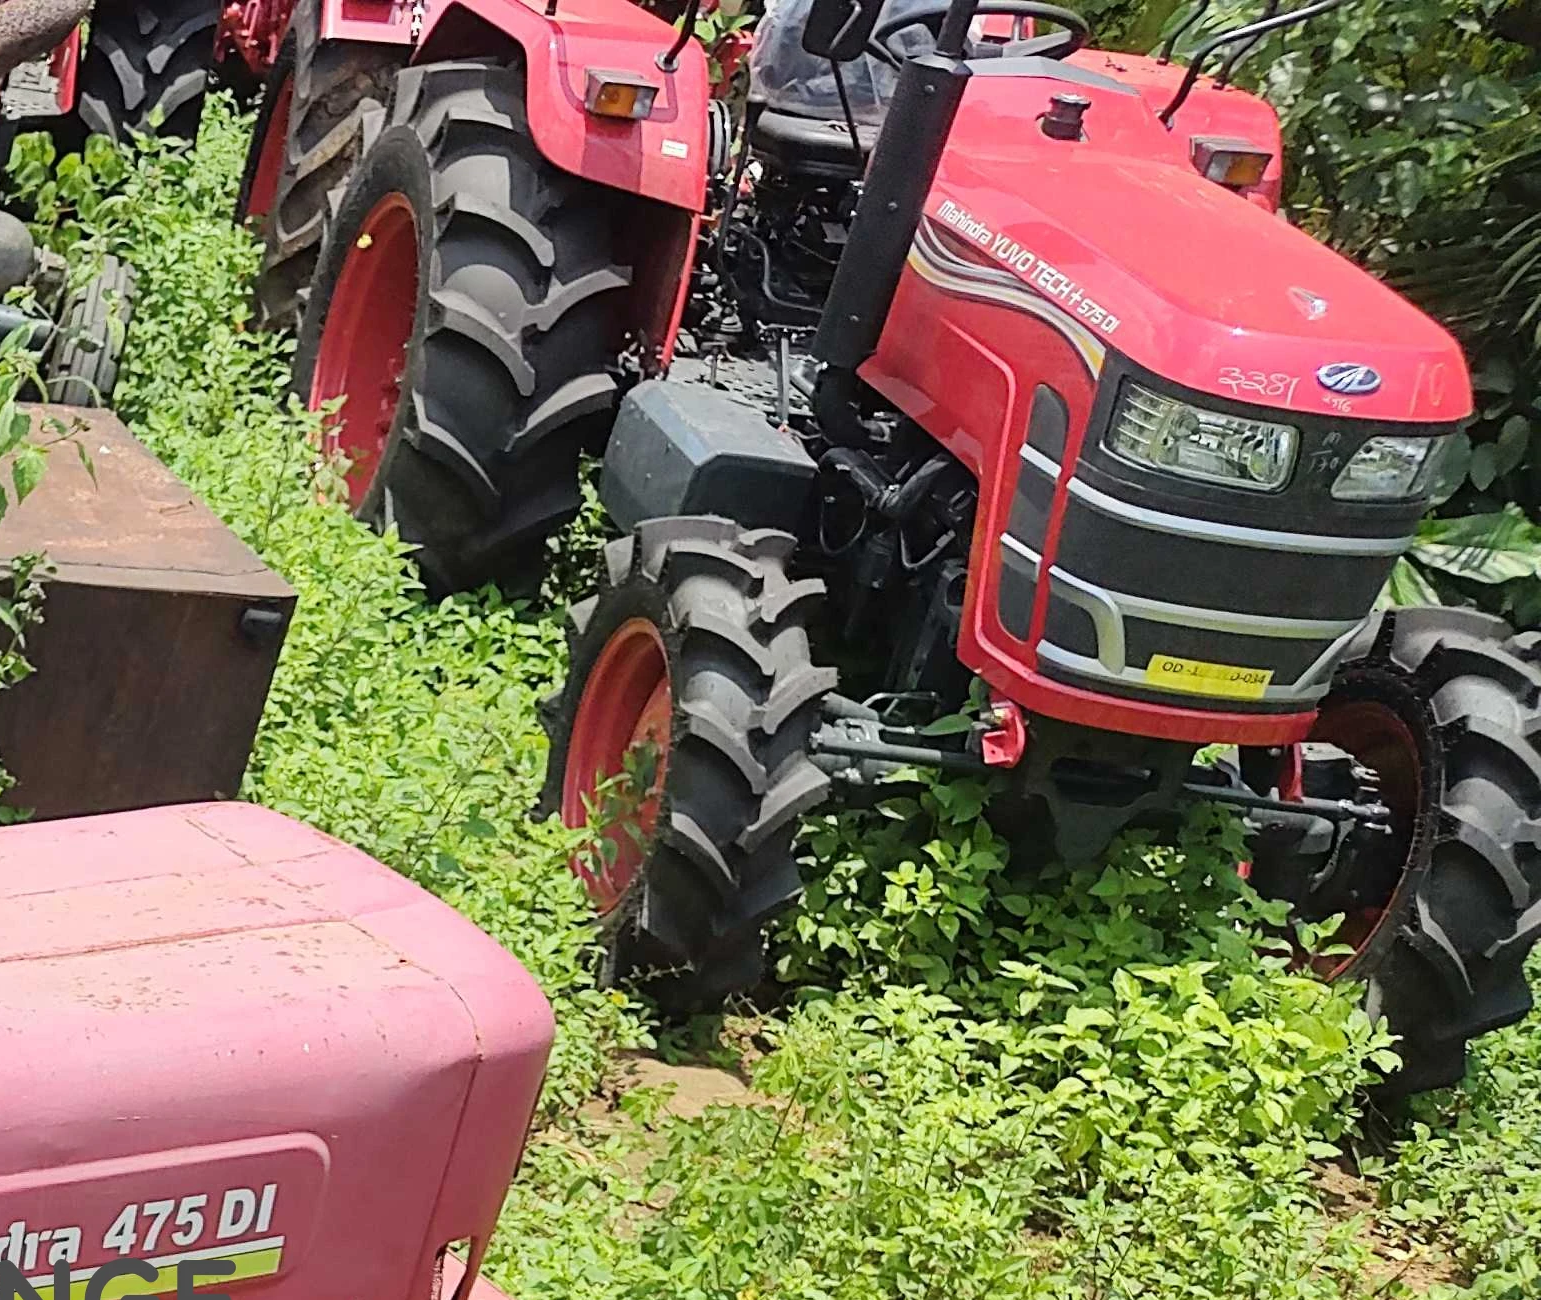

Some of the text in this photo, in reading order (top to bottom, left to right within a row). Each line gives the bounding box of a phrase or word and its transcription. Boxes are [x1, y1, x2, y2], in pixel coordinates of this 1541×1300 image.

[937, 200, 993, 245] Mahindra
[990, 233, 1035, 272] YUVO
[103, 1193, 207, 1256] 475
[216, 1183, 278, 1239] DI
